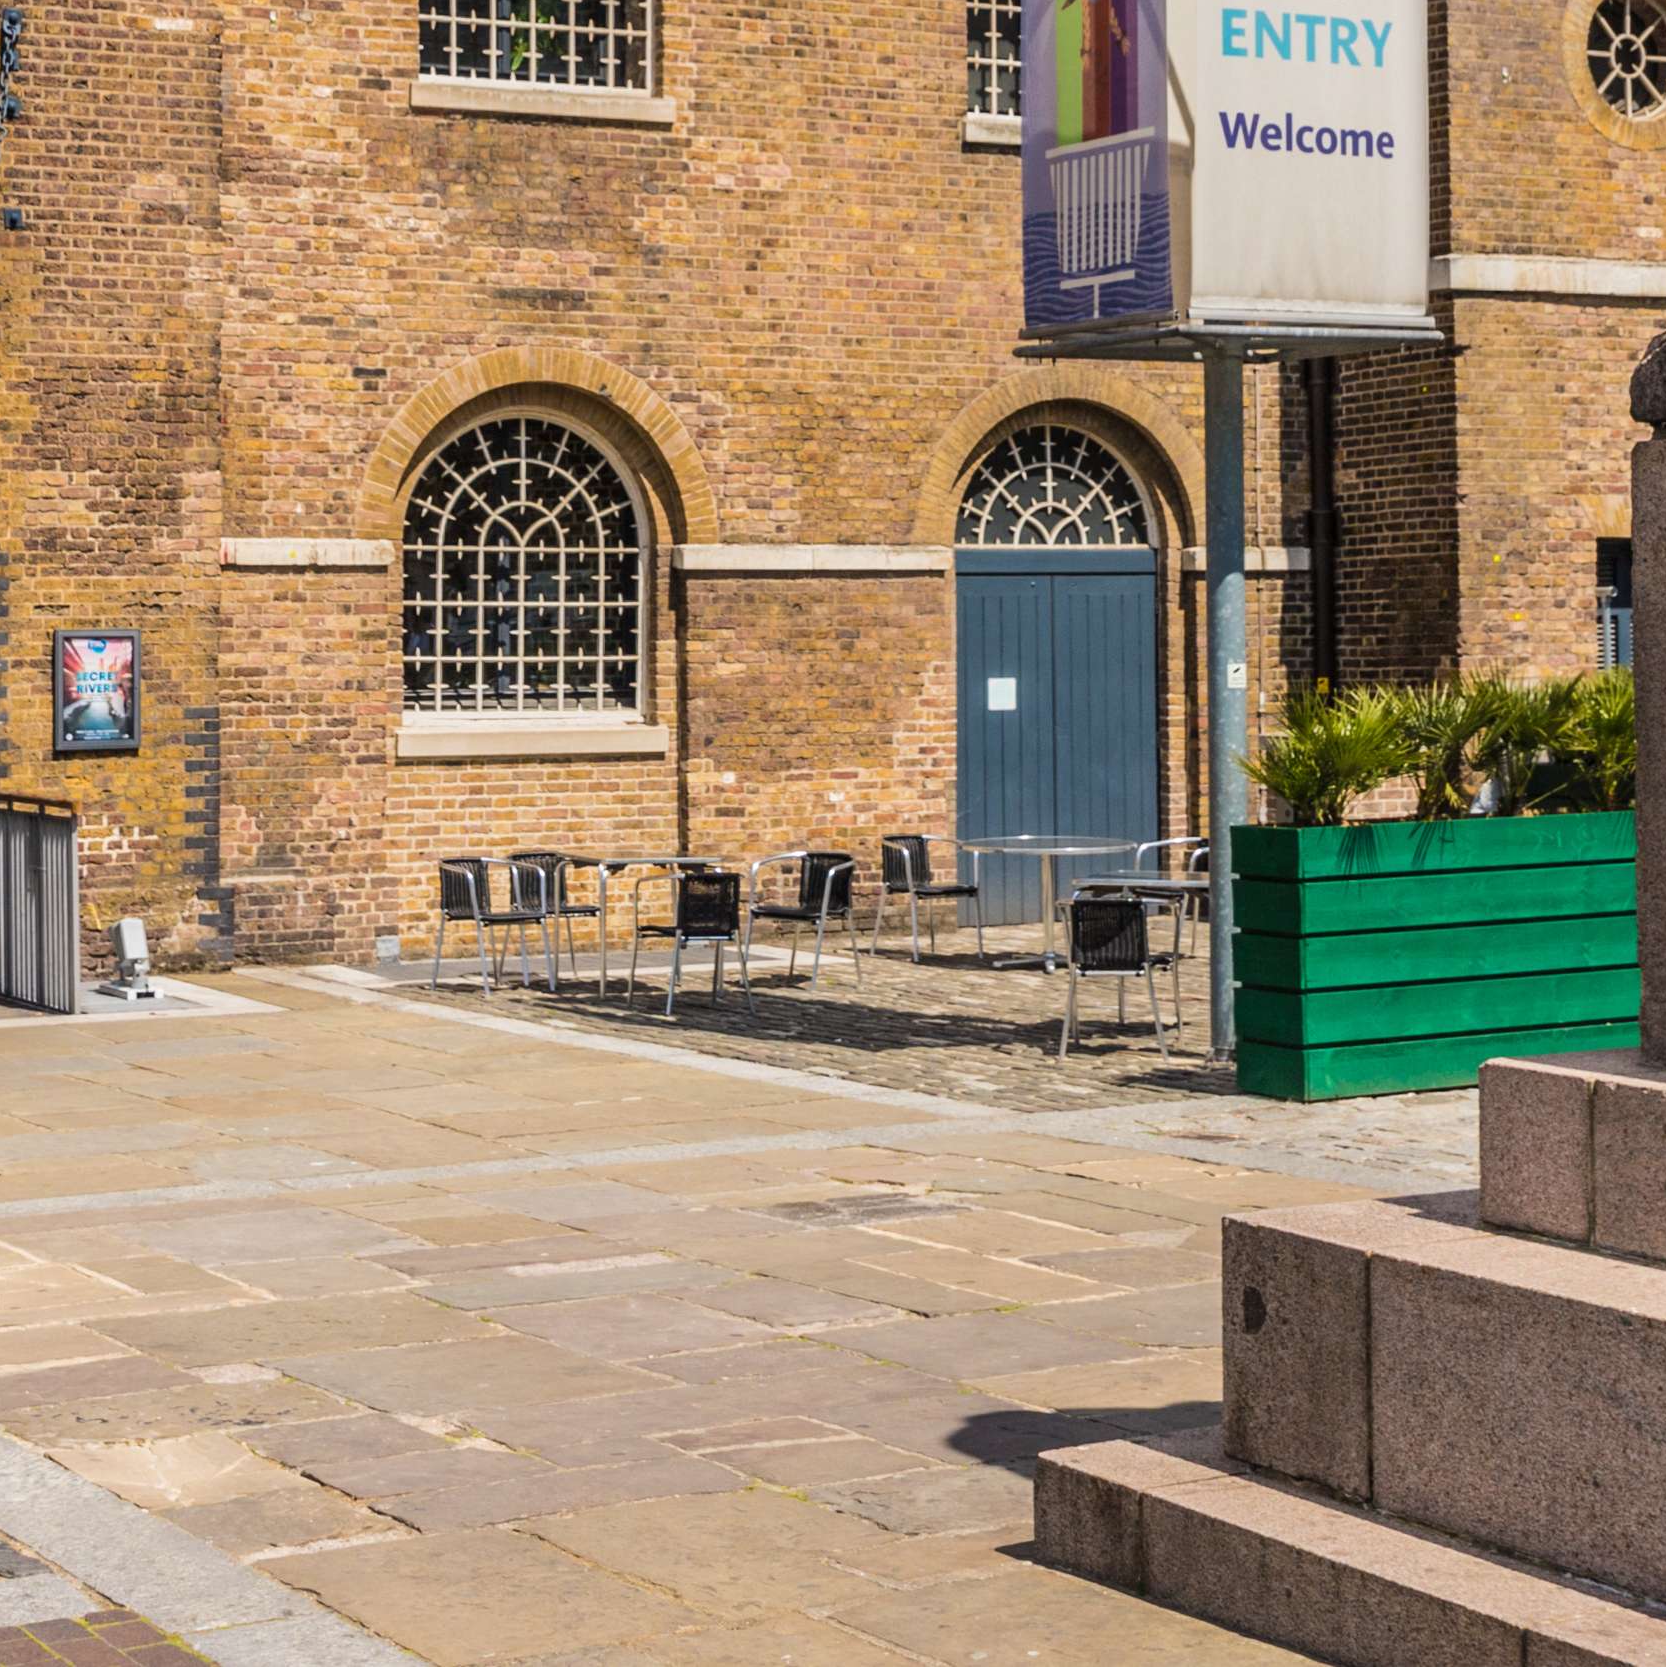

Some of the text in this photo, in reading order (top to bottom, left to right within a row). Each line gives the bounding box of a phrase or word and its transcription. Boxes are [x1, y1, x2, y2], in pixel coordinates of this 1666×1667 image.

[1221, 8, 1393, 68] ENTRY
[1219, 111, 1396, 159] Welcome
[76, 672, 118, 682] SECRE
[77, 684, 117, 694] RIVERS
